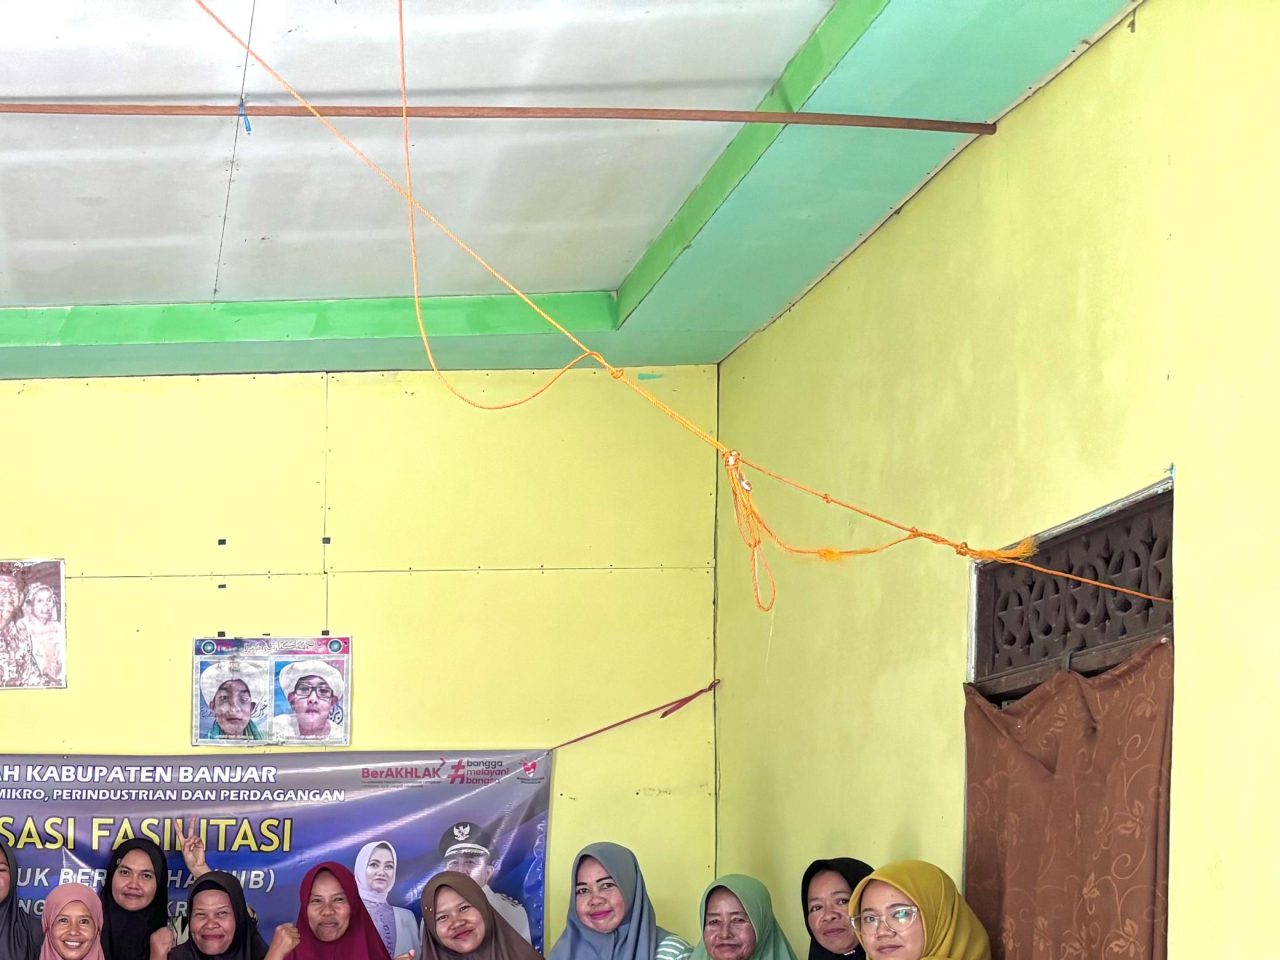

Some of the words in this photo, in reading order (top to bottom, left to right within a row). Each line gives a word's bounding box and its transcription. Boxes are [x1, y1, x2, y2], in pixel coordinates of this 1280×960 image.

[466, 759, 503, 770] bangga
[26, 765, 172, 783] KABUPATEN
[178, 766, 277, 783] BANJAR
[361, 767, 441, 780] BerAKHLAK
[466, 767, 510, 778] melayani
[53, 789, 178, 801] PERINDUSTRIAN
[181, 789, 217, 801] DAN
[220, 789, 345, 801] PERDAGANGAN
